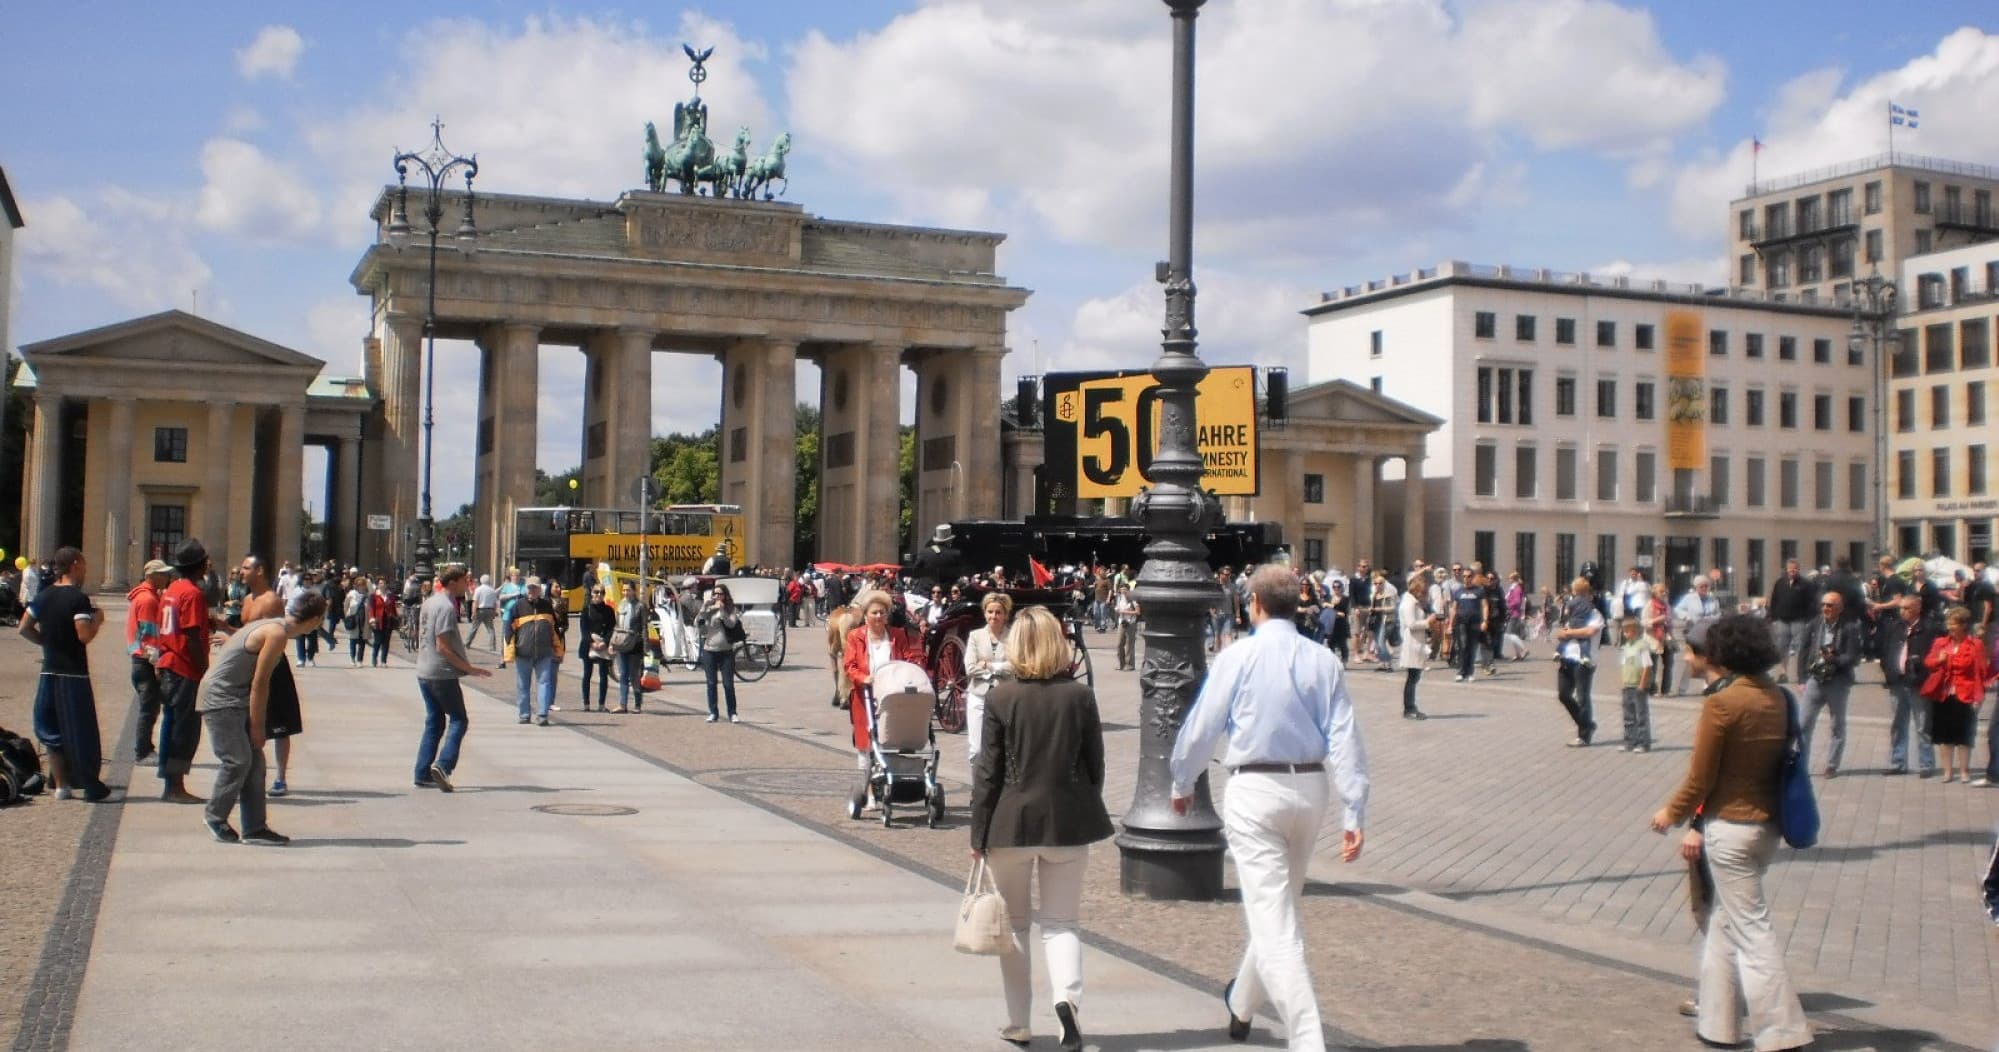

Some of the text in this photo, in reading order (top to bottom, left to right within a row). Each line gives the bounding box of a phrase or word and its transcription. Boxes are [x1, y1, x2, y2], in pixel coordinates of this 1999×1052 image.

[1197, 424, 1247, 447] AHRE
[1199, 451, 1247, 467] MNESTY
[608, 544, 703, 561] DU KANST GROSSES
